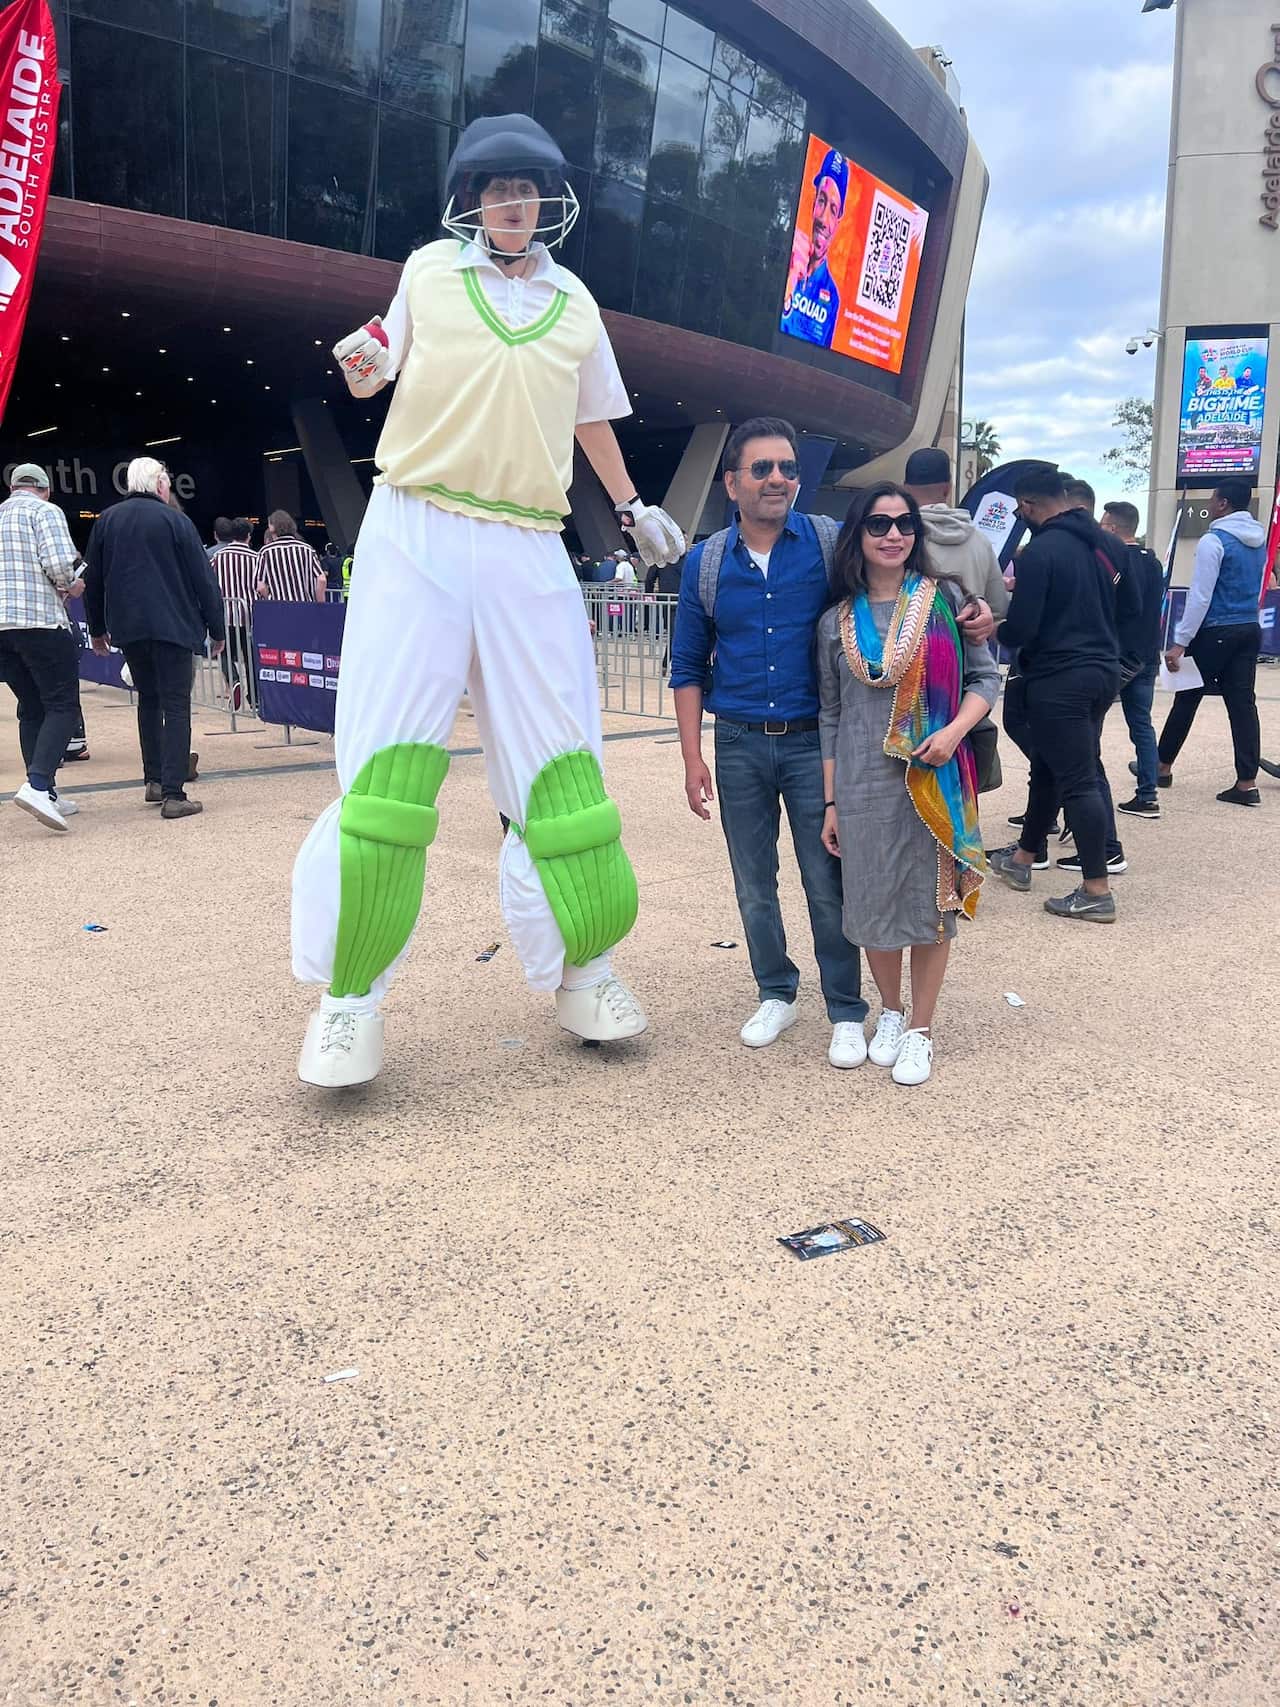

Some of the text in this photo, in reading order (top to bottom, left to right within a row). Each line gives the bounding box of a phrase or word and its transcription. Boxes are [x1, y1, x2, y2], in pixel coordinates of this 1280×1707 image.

[0, 29, 46, 245] ADELAIDE
[18, 174, 39, 249] SOUTH
[792, 292, 828, 324] SQUAD
[1196, 412, 1249, 422] ADELAIDE
